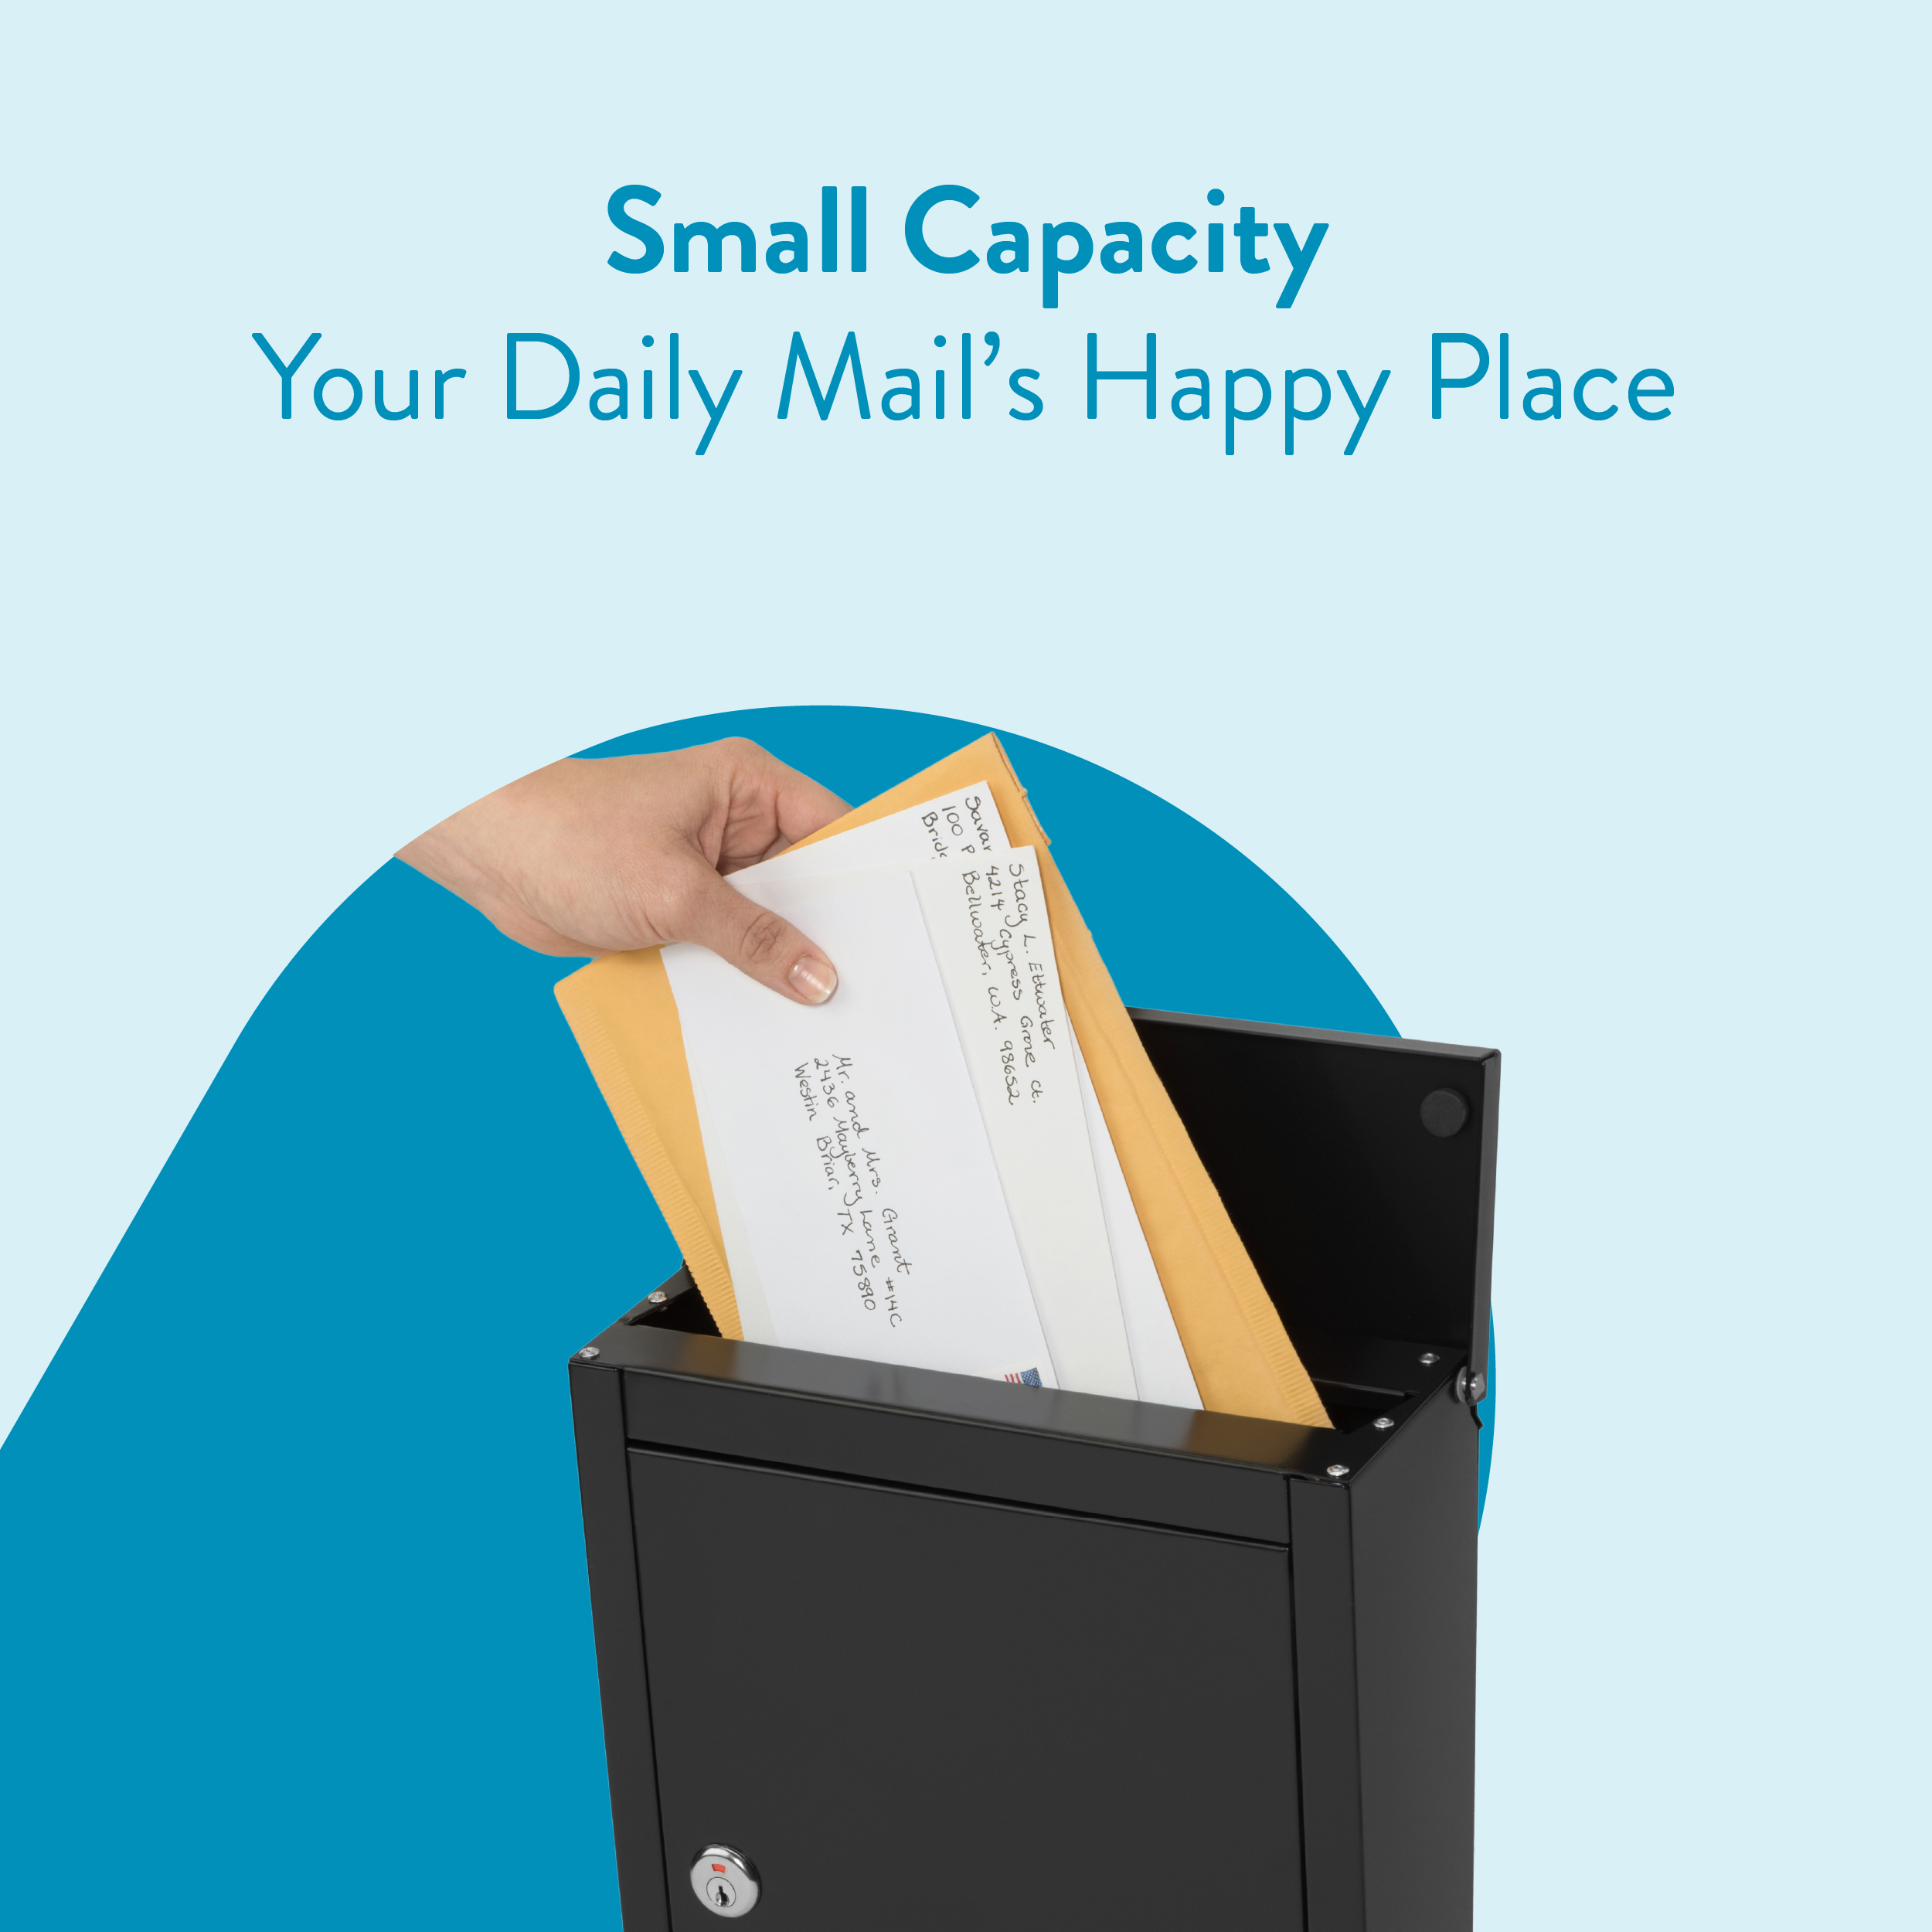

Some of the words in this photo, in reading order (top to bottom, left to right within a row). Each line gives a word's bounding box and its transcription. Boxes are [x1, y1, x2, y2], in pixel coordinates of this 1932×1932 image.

[941, 805, 963, 836] 100
[986, 866, 1005, 910] 4214
[1005, 863, 1029, 927] Stacy
[991, 929, 1022, 1001] Cypress
[1024, 934, 1036, 954] L.
[962, 870, 992, 975] Bellwater,
[1000, 1040, 1020, 1105] 98652
[1029, 962, 1055, 1049] Ettwater
[1020, 1016, 1036, 1067] Grove
[794, 1062, 818, 1121] Westin
[816, 1136, 839, 1190] Briar,
[837, 1208, 854, 1235] TX
[851, 1250, 876, 1311] 75890
[814, 1058, 838, 1108] 2436
[829, 1117, 862, 1206] Mayberry
[860, 1210, 880, 1268] Lane
[885, 1277, 902, 1328] #14C
[832, 1054, 852, 1083] Mr.
[845, 1090, 869, 1139] and
[862, 1148, 881, 1194] Mrs.
[883, 1208, 912, 1275] Grant
